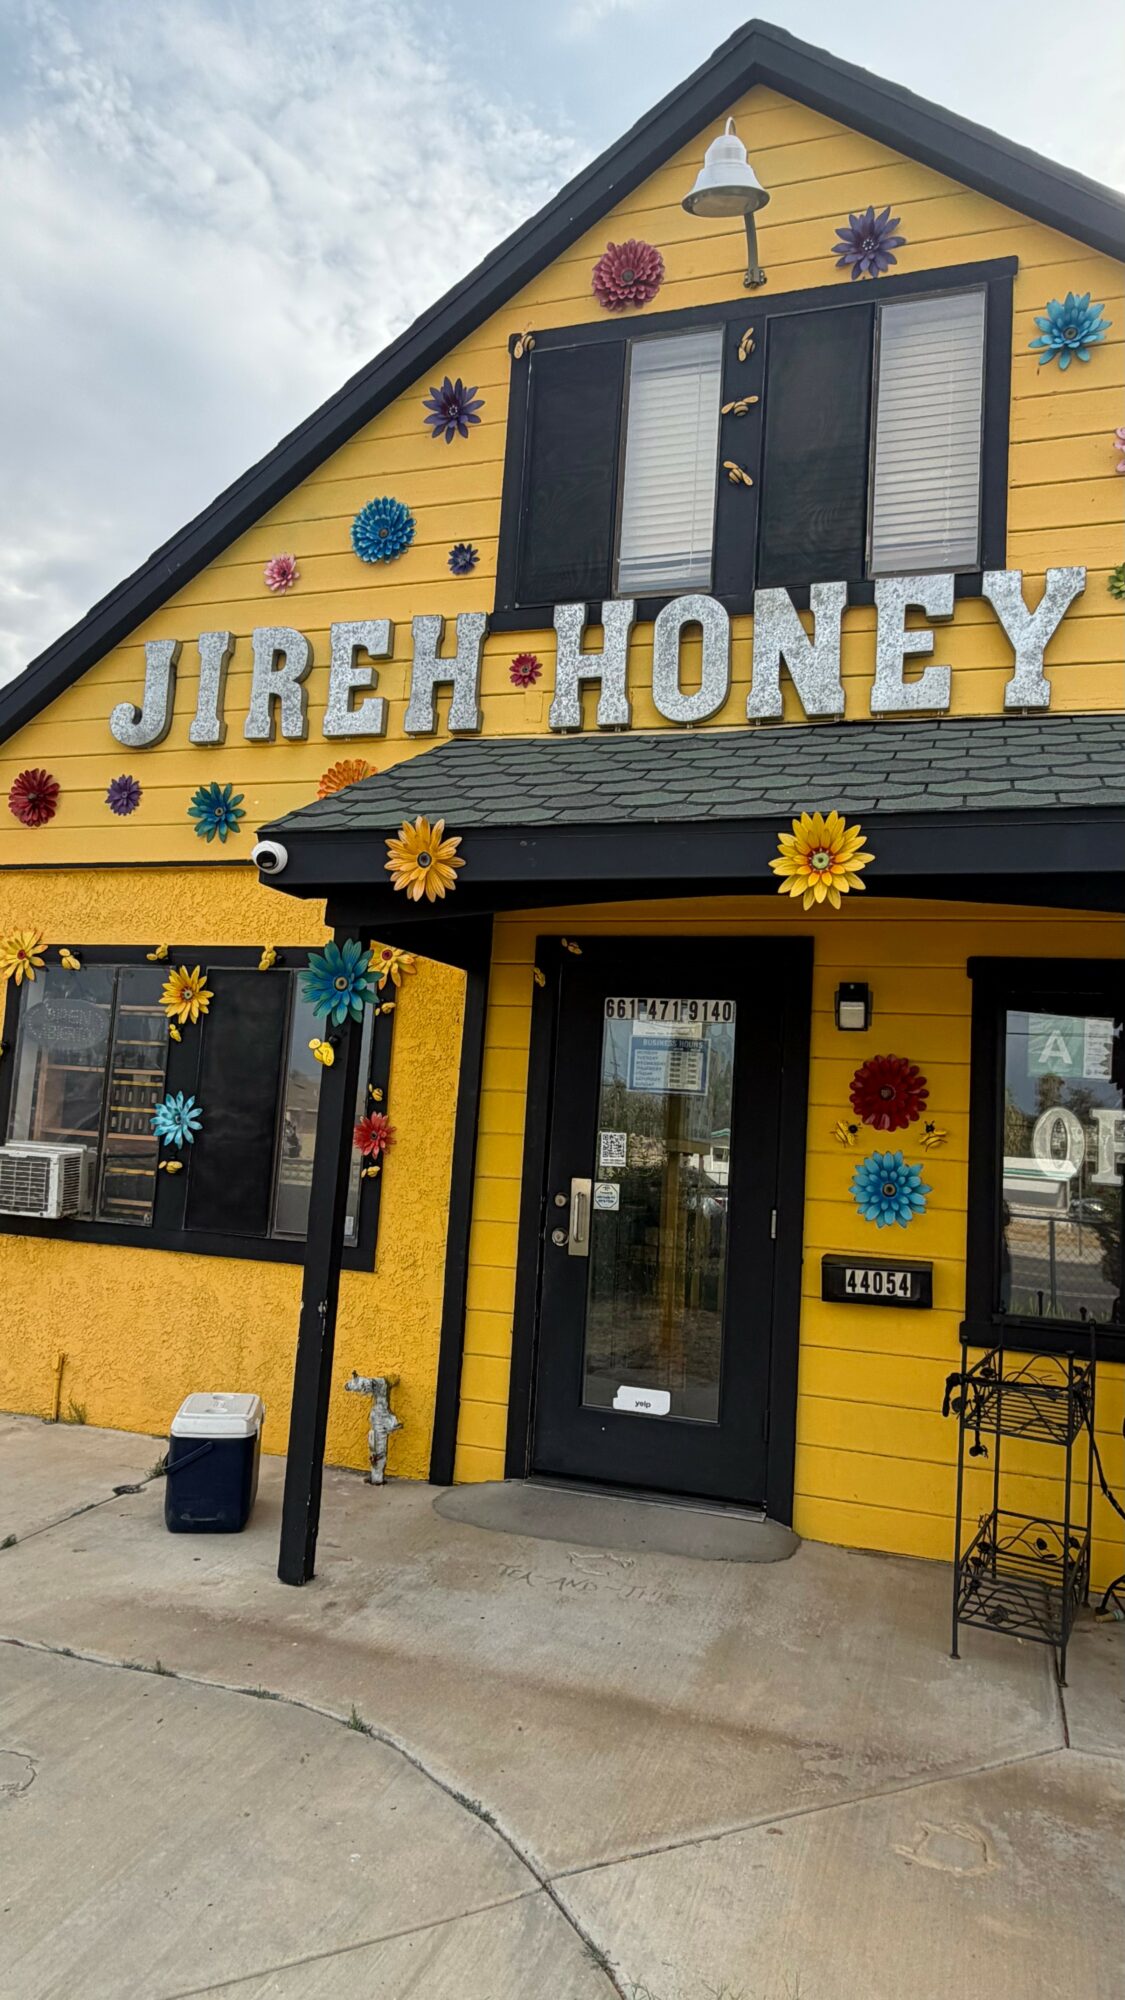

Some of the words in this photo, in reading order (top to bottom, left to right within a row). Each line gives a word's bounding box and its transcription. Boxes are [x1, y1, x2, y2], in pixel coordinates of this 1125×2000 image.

[110, 612, 491, 748] JIREH
[548, 566, 1087, 733] HONEY
[606, 998, 635, 1018] 661
[648, 1000, 679, 1020] 471
[689, 1001, 731, 1021] 9140
[1038, 1029, 1073, 1064] A
[847, 1270, 909, 1296] 44054
[635, 1400, 651, 1409] yelp
